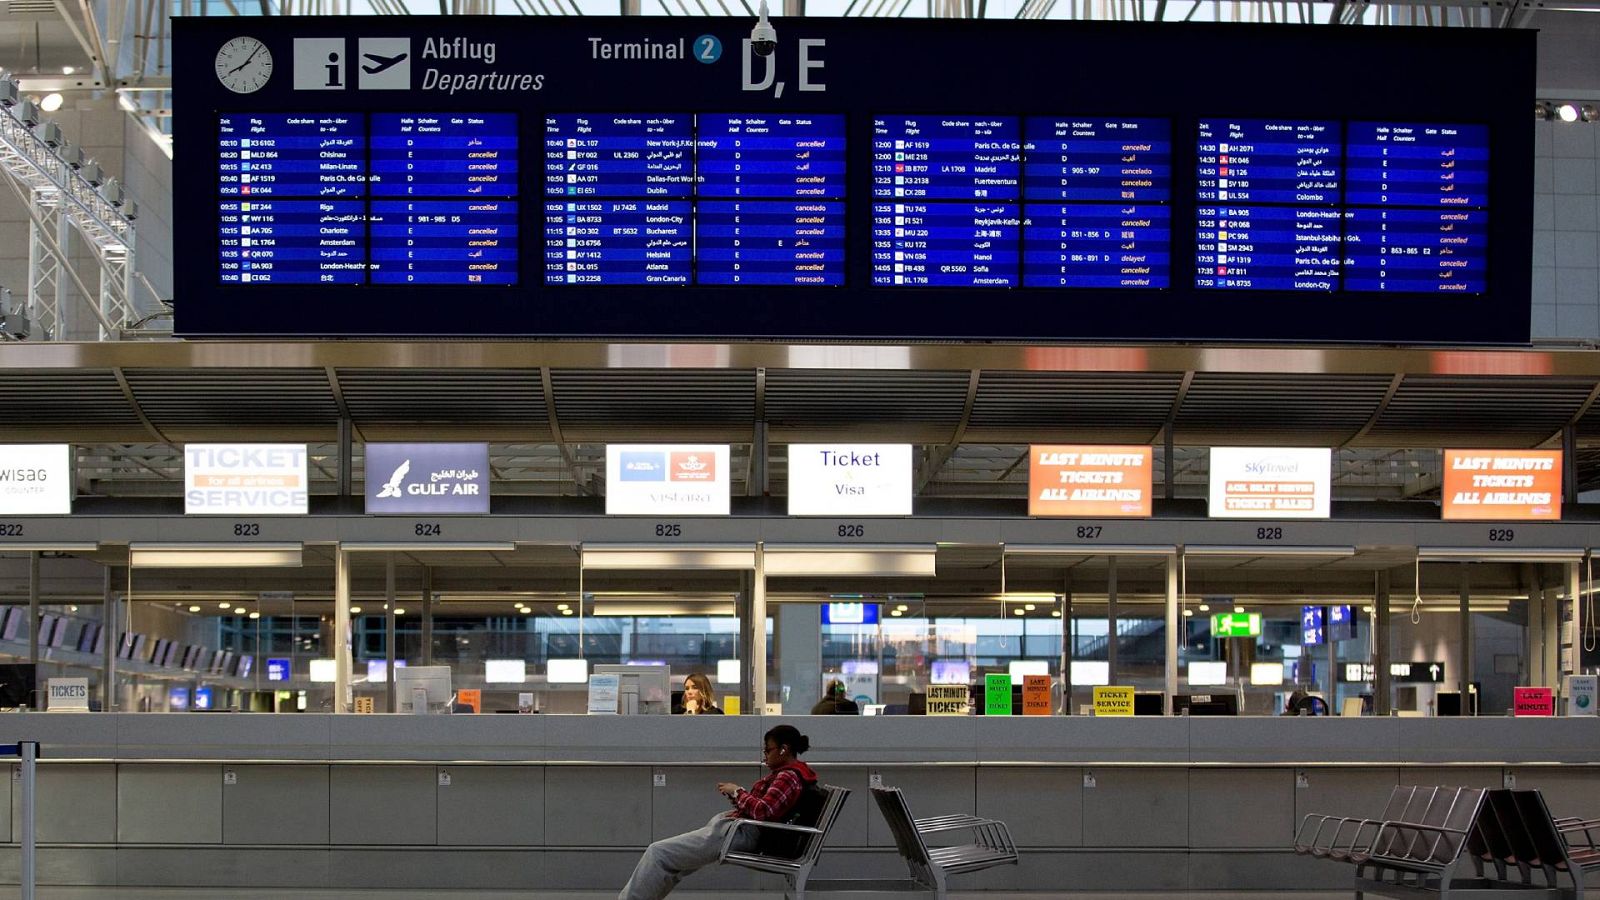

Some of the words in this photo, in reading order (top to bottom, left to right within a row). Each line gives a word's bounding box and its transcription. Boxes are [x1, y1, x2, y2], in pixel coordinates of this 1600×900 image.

[422, 38, 495, 63] Abflug
[588, 38, 683, 59] Terminal
[702, 38, 714, 59] 2
[799, 39, 825, 91] E
[422, 69, 544, 94] Departures
[546, 139, 564, 147] 10:40
[795, 140, 826, 148] cancelled
[875, 141, 892, 149] 12:00
[1121, 144, 1152, 152] cancelled
[1199, 144, 1216, 152] 14:30
[220, 151, 238, 159] 08:20
[467, 151, 498, 159] cancelled
[546, 151, 564, 159] 10:45
[874, 153, 892, 161] 12:00
[1199, 156, 1216, 164] 14:30
[220, 163, 238, 171] 09:15
[546, 163, 564, 171] 10:45
[546, 175, 564, 183] 10:50
[874, 176, 892, 184] 12:25
[974, 177, 1018, 185] Fuerteventura
[1198, 191, 1216, 199] 15:15
[1296, 193, 1324, 201] Colombo
[220, 203, 238, 211] 09:55
[319, 203, 334, 212] Riga
[795, 204, 827, 212] cancelado
[874, 205, 892, 213] 12:55
[646, 215, 684, 224] London-City
[795, 216, 825, 224] cancelled
[1198, 208, 1216, 216] 15:20
[1440, 213, 1469, 221] cancelled
[874, 217, 892, 225] 13:05
[1121, 219, 1151, 227] cancelled
[468, 227, 498, 235] cancelled
[546, 227, 564, 235] 11:15
[646, 227, 678, 235] Bucharest
[468, 239, 498, 247] cancelled
[546, 239, 564, 247] 11:20
[1198, 232, 1215, 240] 15:30
[1439, 236, 1469, 244] cancelled
[221, 250, 239, 258] 10:35
[546, 251, 564, 259] 11:35
[646, 251, 671, 259] Helsinki
[874, 252, 892, 260] 13:55
[973, 253, 993, 261] Hanoi
[1197, 255, 1215, 263] 17:35
[221, 262, 239, 270] 10:40
[546, 263, 564, 271] 11:35
[645, 263, 669, 271] Atlanta
[874, 264, 891, 272] 14:05
[874, 276, 891, 284] 14:15
[973, 277, 1009, 285] Amsterdam
[1294, 281, 1331, 290] London-City
[1438, 283, 1467, 291] cancelled
[187, 448, 305, 468] TICKET
[820, 450, 880, 466] Ticket
[1039, 453, 1079, 465] LAST
[1080, 453, 1144, 466] MINUTE
[1453, 457, 1491, 470] LAST
[1492, 457, 1554, 470] MINUTE
[431, 469, 455, 482] الخليج
[456, 470, 479, 481] طيران
[1059, 470, 1124, 483] TICKETS
[1472, 475, 1535, 487] TICKETS
[408, 484, 450, 495] GULF
[452, 484, 479, 495] AIR
[836, 484, 865, 495] Visa
[1039, 488, 1068, 500] ALL
[187, 490, 307, 506] SERVICE
[1452, 492, 1480, 504] ALL
[1482, 492, 1552, 504] AIRLINES
[0, 524, 24, 536] 822
[234, 524, 259, 536] 823
[415, 524, 441, 536] 824
[655, 525, 681, 536] 825
[838, 525, 864, 537] 826
[1076, 526, 1102, 538] 827
[1257, 527, 1282, 539] 828
[1489, 529, 1514, 541] 829
[50, 685, 86, 697] TICKETS
[928, 687, 942, 698] LAST
[943, 687, 967, 698] MINUTE
